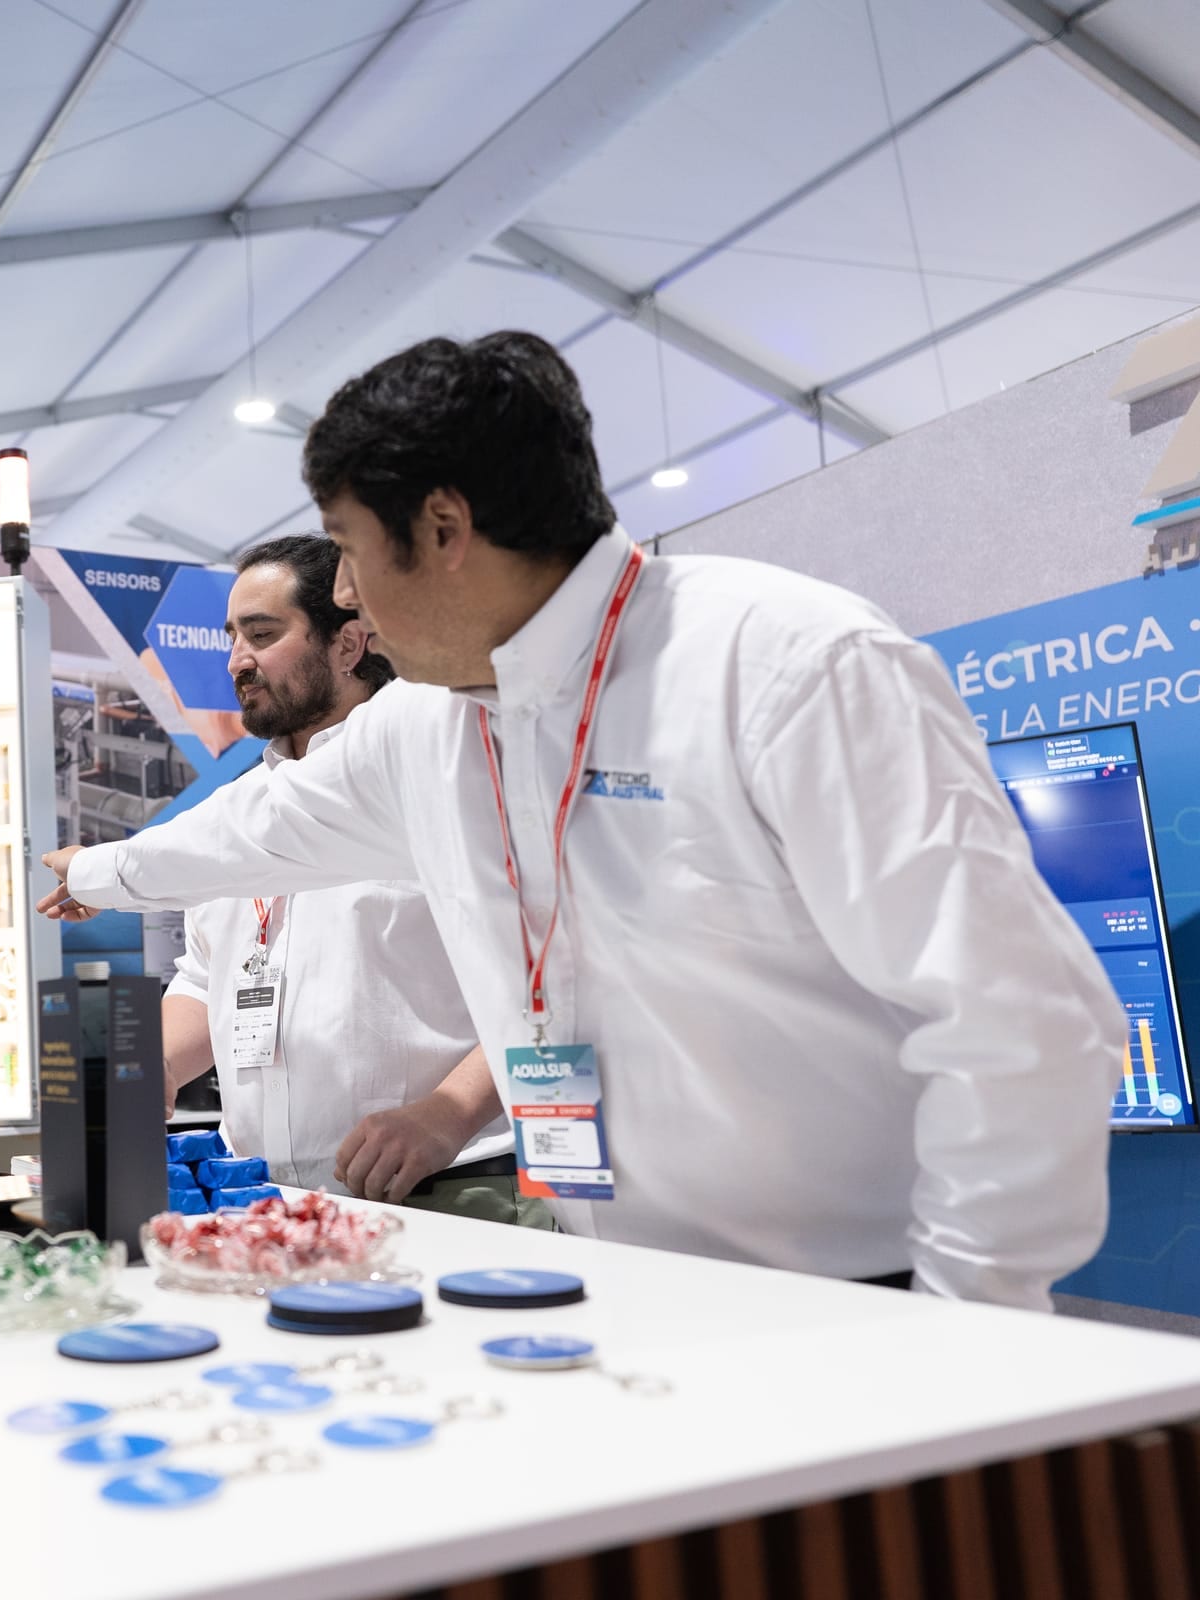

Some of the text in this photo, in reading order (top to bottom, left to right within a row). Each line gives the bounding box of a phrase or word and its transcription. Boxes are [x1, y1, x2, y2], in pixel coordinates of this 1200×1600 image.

[84, 569, 162, 592] SENSORS
[156, 623, 233, 652] TECNOAU
[956, 616, 1175, 697] ÉCTRICA
[1000, 703, 1046, 739] LA
[1058, 669, 1200, 729] ENERG
[511, 1063, 575, 1079] AQUASUR
